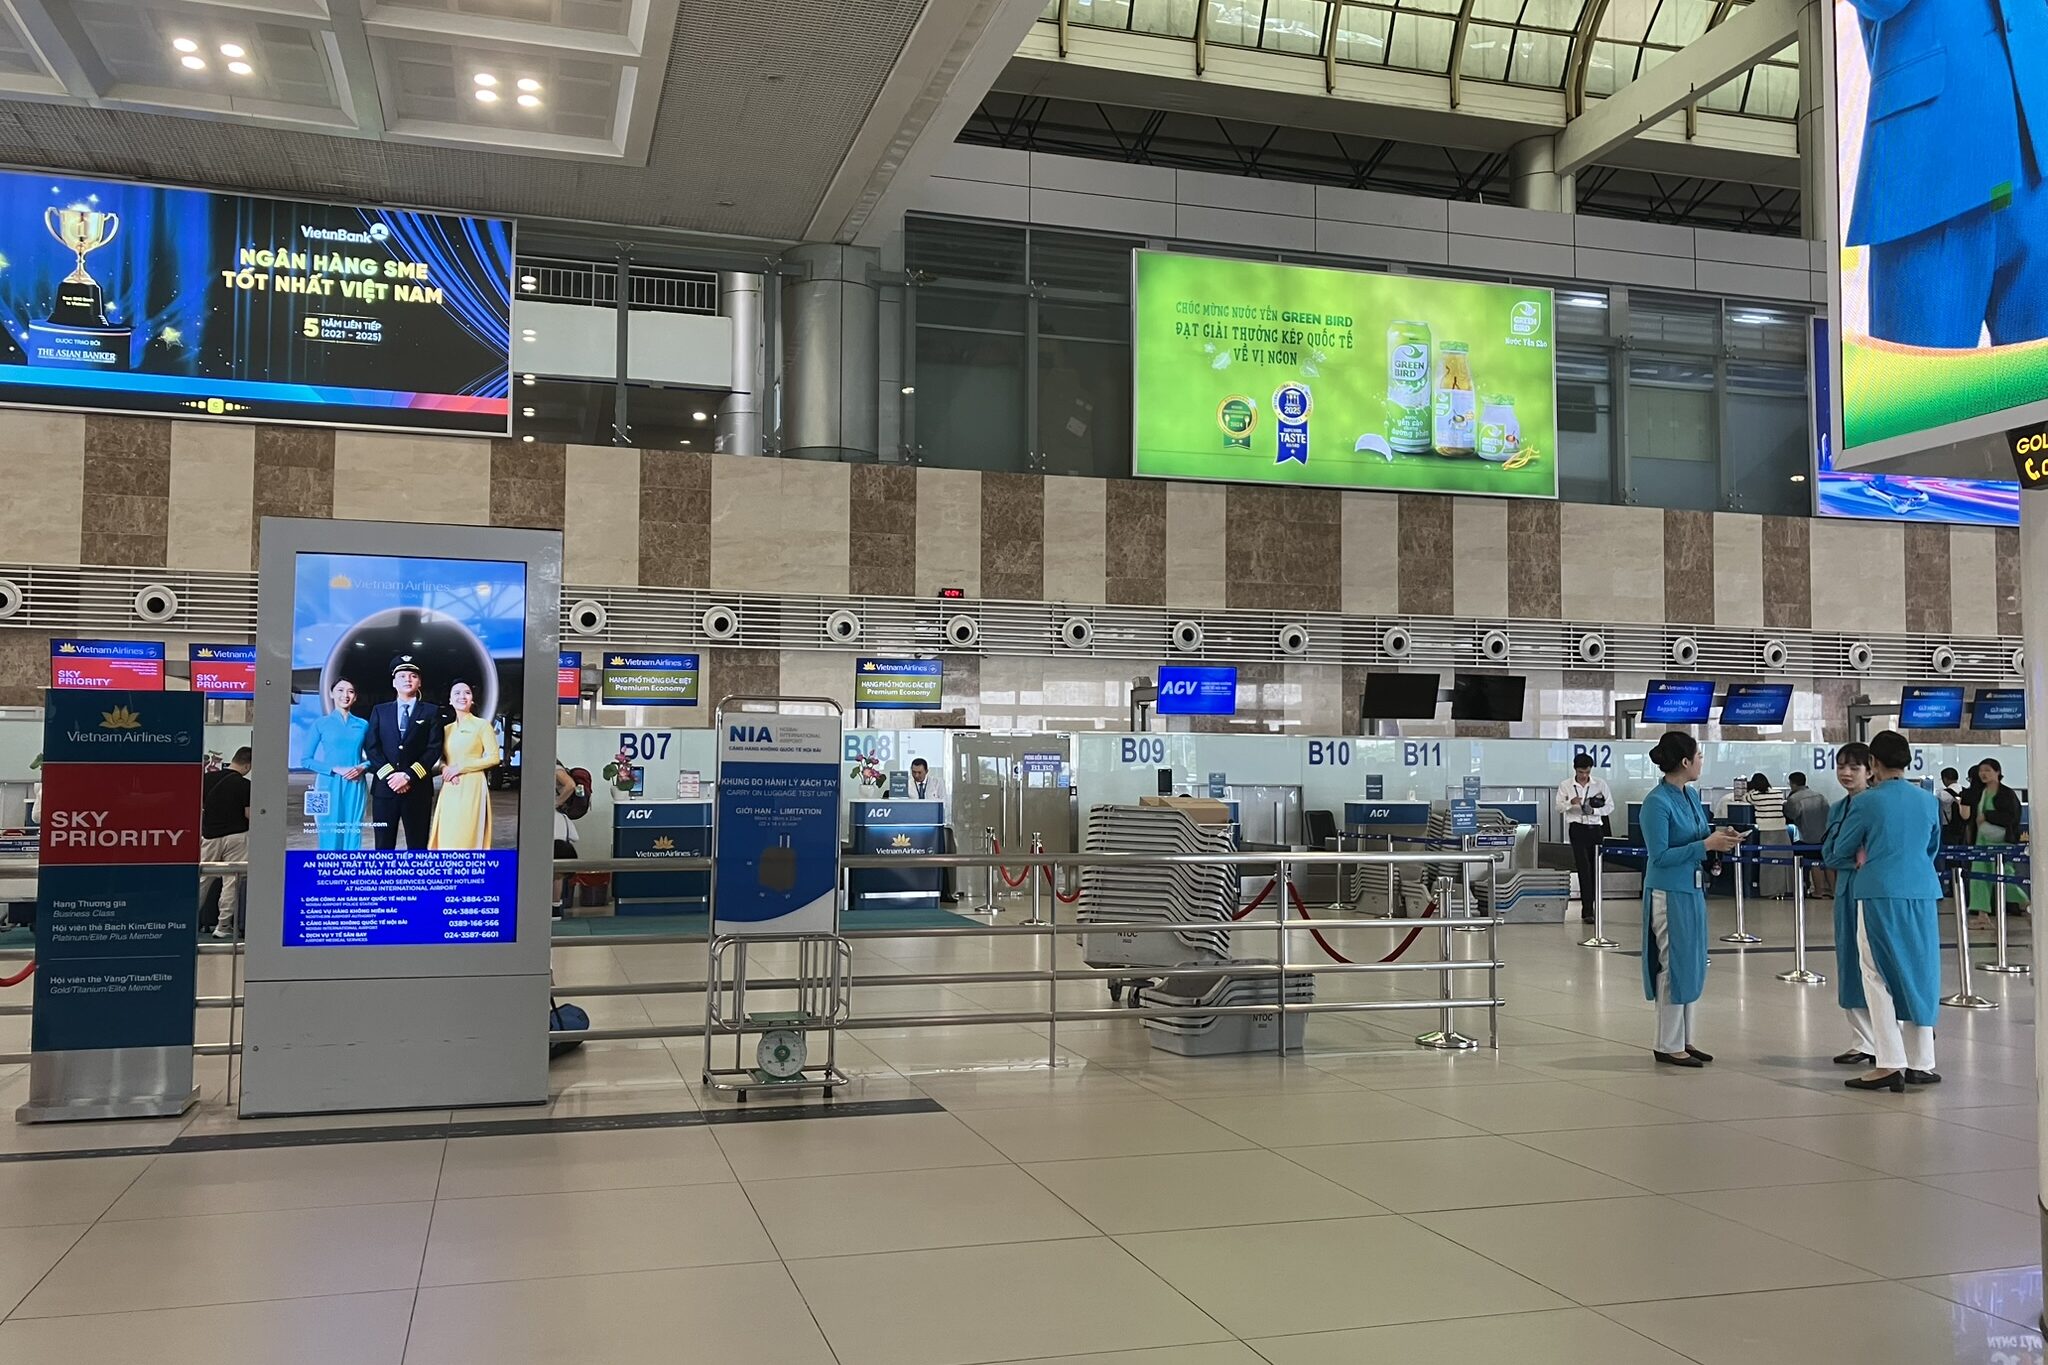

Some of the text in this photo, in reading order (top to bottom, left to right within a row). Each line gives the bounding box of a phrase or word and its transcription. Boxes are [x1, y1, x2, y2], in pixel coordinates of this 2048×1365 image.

[301, 225, 372, 244] VietinBank
[240, 248, 429, 281] NGÂN HÀNG SME
[221, 268, 443, 304] TỐT NHẤT VIỆT NAM
[1176, 299, 1353, 327] CHÚC MỪNG NƯỚC YẾN GREEN BIRD
[303, 318, 319, 337] 5
[321, 318, 381, 331] NĂM LIÊN TIẾP
[321, 328, 381, 342] (2021 2025)
[1175, 321, 1353, 349] ĐẠT GIẢI THƯỞNG KÉP QUỐC TẾ
[38, 348, 115, 361] THE ASIAN BANKER
[1234, 343, 1297, 367] VỀ VỊ NGON
[1395, 360, 1425, 370] GREEN
[1395, 369, 1416, 378] BIRD
[1279, 433, 1307, 444] TASTE
[76, 645, 144, 655] Vietnam Airlines
[213, 650, 246, 659] Vietnam
[625, 658, 682, 667] Vietnam Airlines
[876, 663, 928, 672] Vietnam Airlines
[58, 669, 81, 678] SKY
[197, 674, 218, 682] SKY
[58, 677, 111, 686] PRIORITY
[197, 681, 246, 689] PRIORITY
[651, 685, 686, 693] Economy
[899, 689, 931, 697] Economy
[1161, 681, 1198, 695] ACV
[67, 731, 172, 743] Vietnam Airlines
[730, 726, 773, 743] NIA
[619, 733, 672, 760] B07
[844, 735, 891, 762] B08
[1121, 738, 1164, 764] B09
[1308, 740, 1350, 766] B10
[1404, 742, 1441, 767] B11
[1814, 747, 1835, 770] B1
[721, 776, 837, 787] KHUNG ĐO HÀNH LÝ XÁCH TAY
[626, 809, 653, 819] ACV
[867, 808, 892, 818] ACV
[1369, 809, 1390, 818] ACV
[51, 811, 109, 828] SKY
[51, 829, 184, 847] PRIORITY
[316, 852, 348, 860] ĐƯỜNG
[349, 852, 366, 860] DÂY
[368, 852, 393, 860] NÓNG
[395, 852, 414, 860] TIẾP
[415, 852, 439, 860] NHẬN
[441, 852, 470, 860] THÔNG
[635, 850, 665, 858] Vietnam
[341, 860, 363, 869] TRẬT
[386, 859, 397, 868] TẾ
[398, 860, 409, 868] VÀ
[411, 859, 434, 868] CHẤT
[434, 860, 464, 869] LƯỢNG
[465, 860, 486, 868] DỊCH
[487, 860, 499, 869] VỤ
[317, 867, 485, 877] TẠI CẢNG HÀNG KHÔNG QUỐC TẾ NỘI BÀI
[53, 910, 90, 918] Business
[168, 921, 186, 929] Plus
[52, 933, 108, 942] Platinum/Elite
[129, 932, 163, 940] Member
[444, 931, 499, 939] 024-3587-6601
[50, 984, 162, 994] Gold/Titanium/Elite Member
[1252, 1013, 1273, 1021] NTOC
